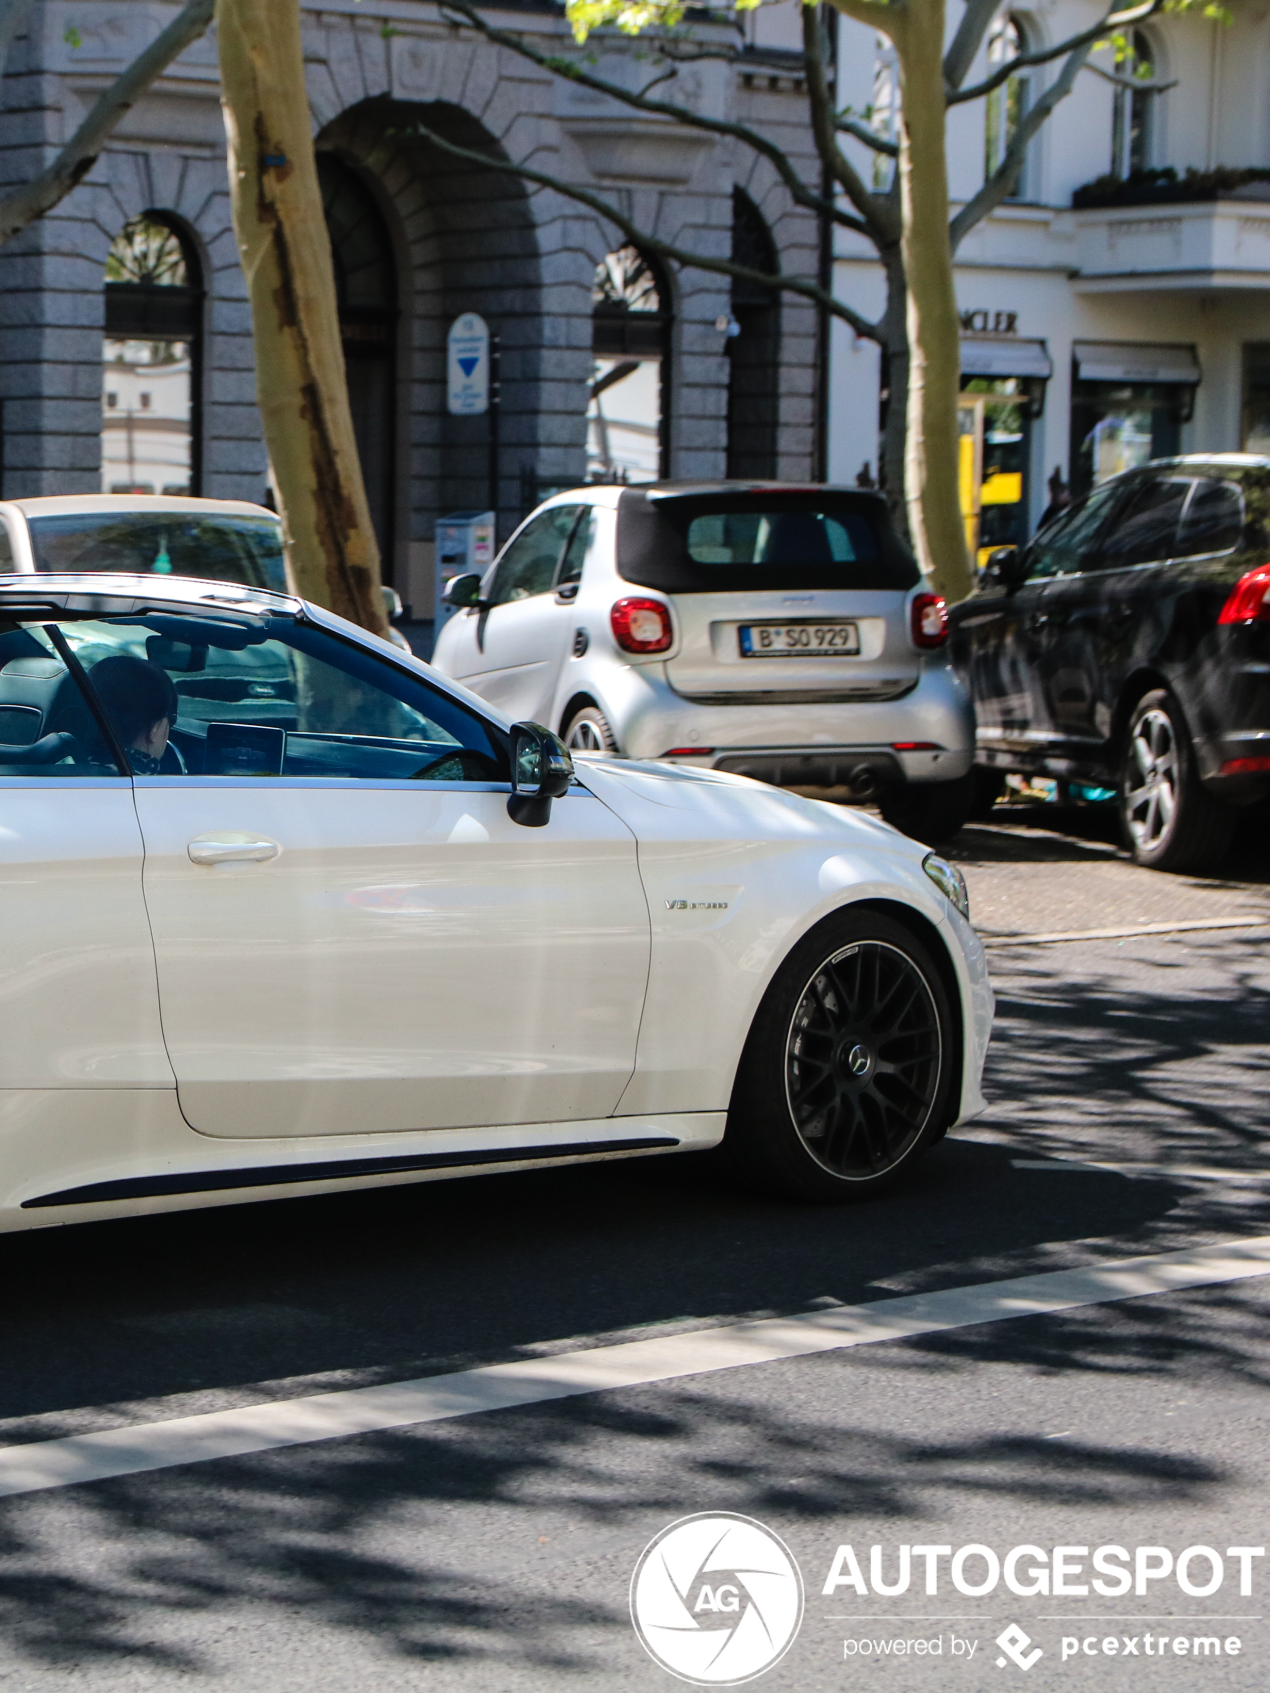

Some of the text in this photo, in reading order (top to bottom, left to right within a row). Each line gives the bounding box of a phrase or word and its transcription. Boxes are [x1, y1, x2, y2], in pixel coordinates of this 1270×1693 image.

[959, 308, 1018, 333] NCLER
[759, 627, 850, 648] B SO 929
[664, 899, 688, 911] V8
